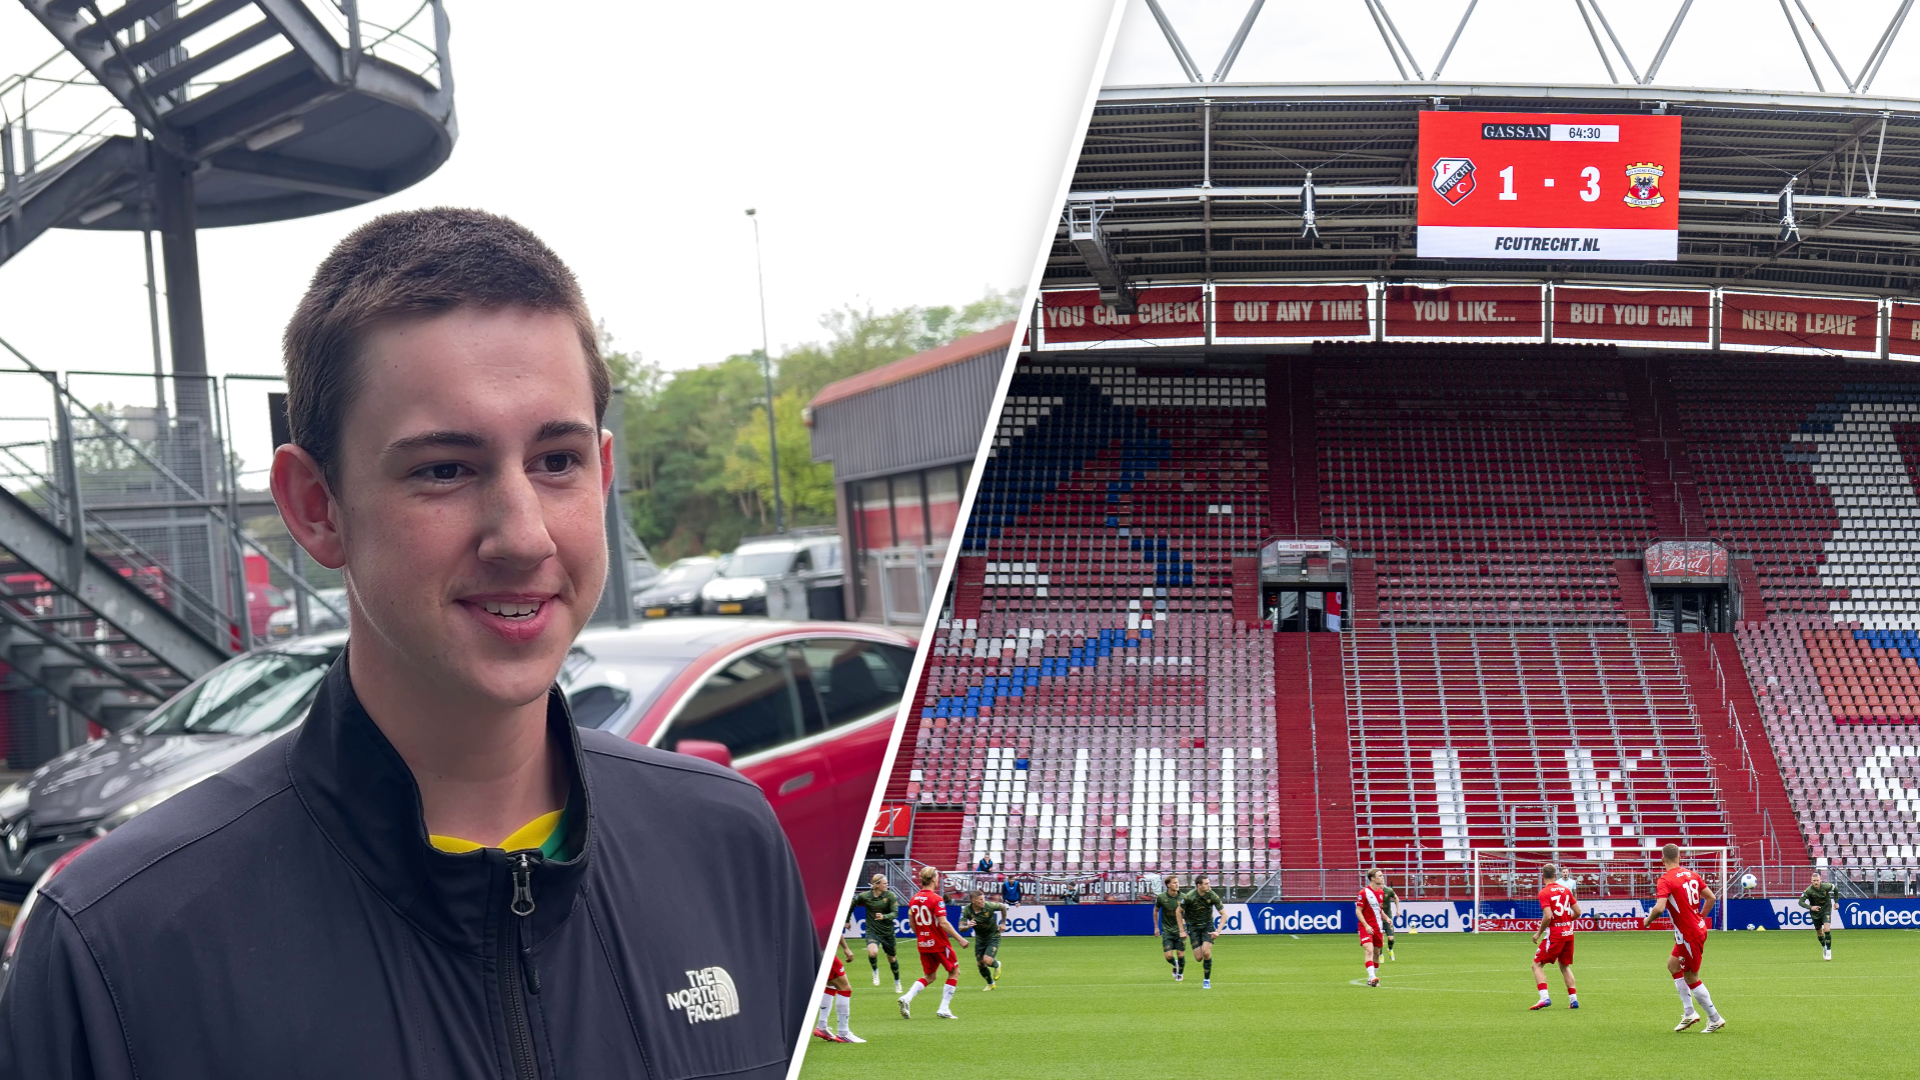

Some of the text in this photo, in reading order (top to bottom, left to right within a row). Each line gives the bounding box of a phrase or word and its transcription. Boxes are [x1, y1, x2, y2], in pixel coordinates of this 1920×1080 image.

[1484, 125, 1601, 139] GASSAN 64:30
[1439, 161, 1472, 196] UTRECHT
[1443, 163, 1450, 175] F
[1456, 182, 1467, 194] C
[1499, 165, 1518, 200] 1
[1579, 166, 1601, 202] 3
[1495, 236, 1601, 252] FCUTRECHT.NL
[1046, 301, 1200, 328] YOU CAN CHECK
[1233, 300, 1364, 322] OUT ANY TIME
[1413, 300, 1516, 322] YOU LIKE...
[1570, 303, 1693, 327] BUT YOU CAN
[1742, 309, 1857, 336] NEVER LEAVE
[1668, 555, 1704, 570] Bud
[1682, 879, 1700, 906] 18
[910, 904, 932, 926] 20
[1550, 894, 1571, 917] 34
[1264, 910, 1342, 931] indeed
[1502, 920, 1542, 931] JACK'S
[1598, 919, 1639, 930] Utrecht
[685, 967, 715, 988] THE
[666, 985, 718, 1011] NORTH
[686, 1000, 722, 1025] FACE
